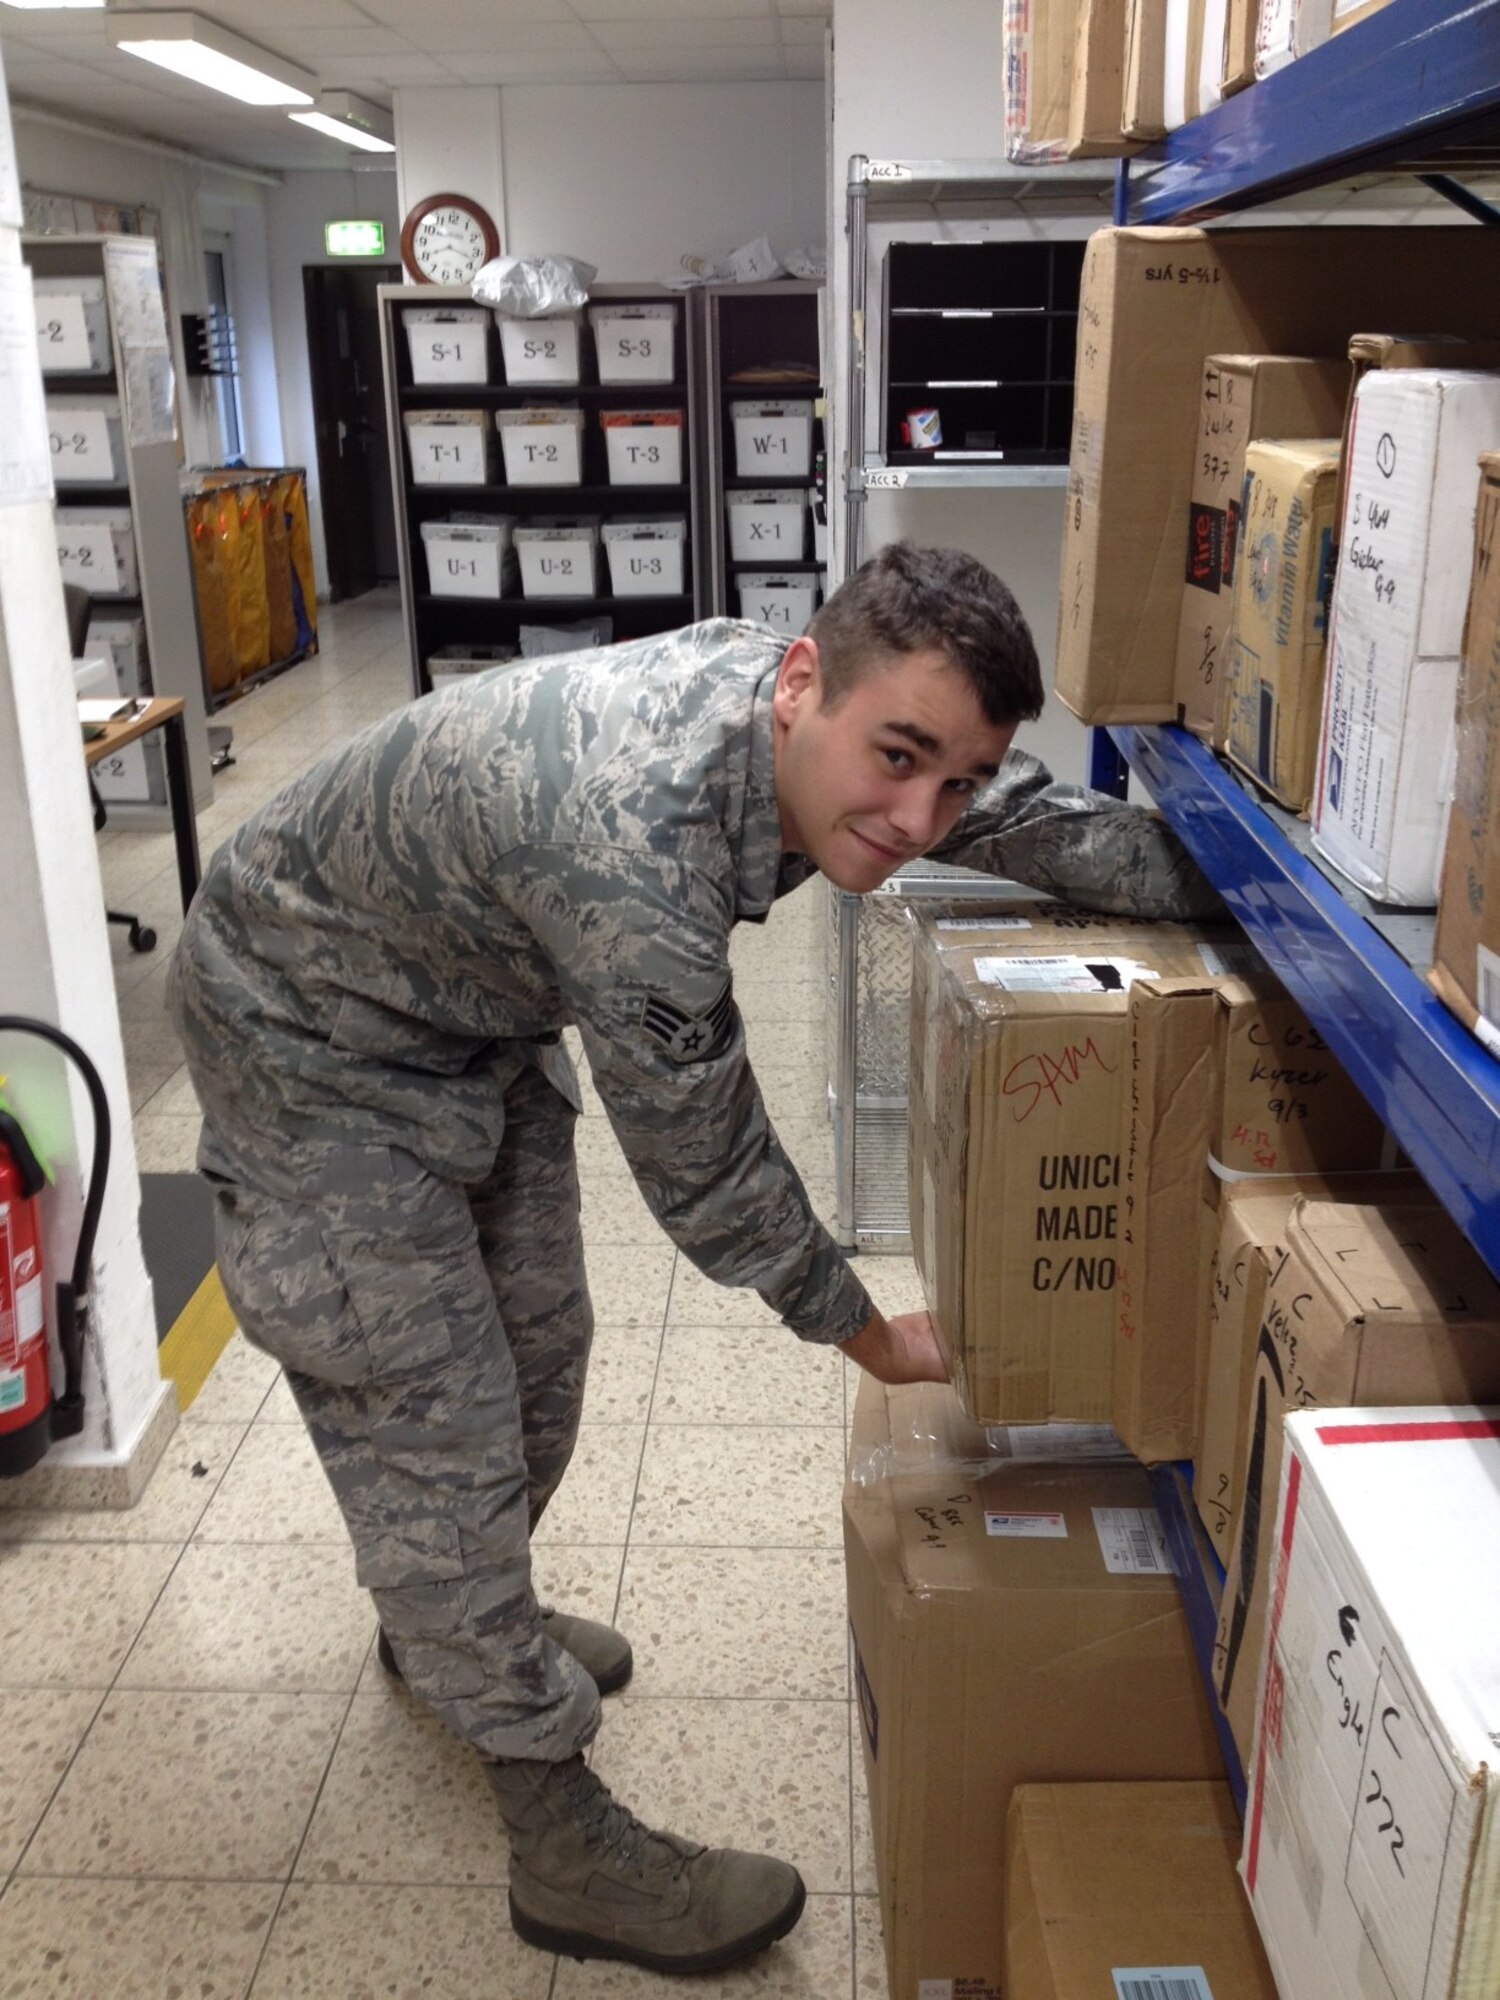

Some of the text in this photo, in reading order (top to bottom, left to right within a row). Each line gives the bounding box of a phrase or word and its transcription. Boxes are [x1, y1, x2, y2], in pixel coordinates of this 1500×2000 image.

[871, 166, 892, 178] ACC
[435, 216, 445, 226] 11
[448, 213, 460, 225] 12
[464, 221, 469, 231] 1
[424, 225, 436, 235] 10
[469, 234, 478, 243] 2
[419, 238, 428, 247] 9
[421, 252, 430, 262] 8
[471, 248, 480, 258] 3
[430, 263, 437, 274] 7
[454, 268, 463, 279] 5
[465, 261, 474, 271] 4
[1144, 264, 1173, 281] yrs
[441, 270, 450, 281] 6
[38, 320, 64, 343] -2
[431, 343, 463, 362] S-1
[523, 340, 557, 359] S-2
[618, 339, 652, 358] S-3
[429, 444, 463, 463] T-1
[523, 444, 559, 463] T-2
[752, 435, 789, 455] W-1
[626, 446, 661, 464] T-3
[870, 475, 900, 486] ACC 2
[749, 522, 783, 541] X-1
[447, 559, 478, 577] U-1
[540, 558, 573, 577] U-2
[629, 557, 662, 576] U-3
[760, 603, 791, 624] Y-1
[1036, 1204, 1117, 1242] MADE
[1032, 1256, 1117, 1292] C/NO
[1381, 1706, 1403, 1760] C
[1365, 1769, 1406, 1879] 772
